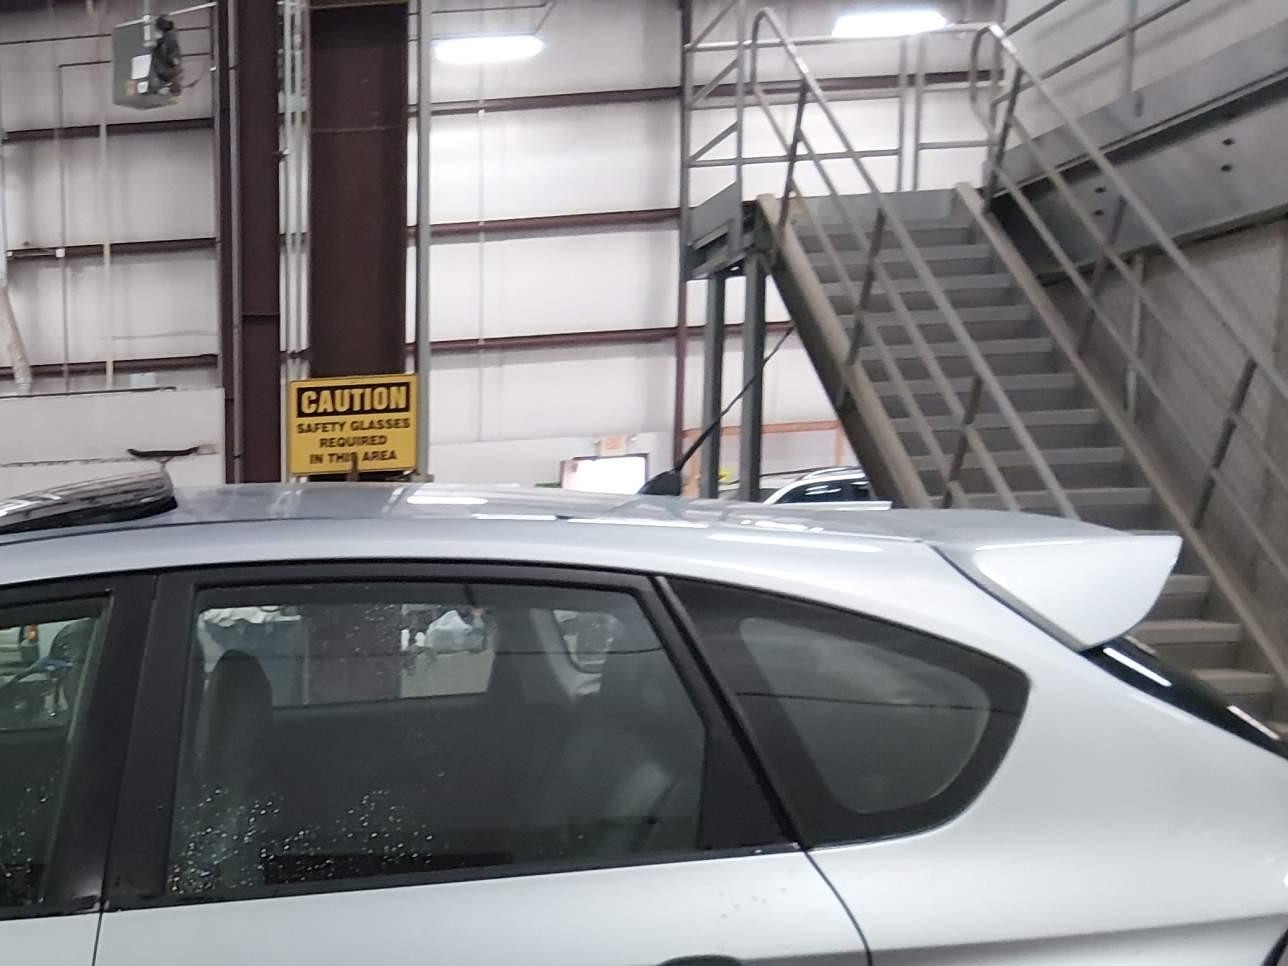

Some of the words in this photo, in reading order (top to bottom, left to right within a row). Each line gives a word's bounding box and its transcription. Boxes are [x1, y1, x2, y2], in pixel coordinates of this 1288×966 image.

[302, 386, 407, 413] CAUTION
[296, 421, 346, 433] SAFETY
[350, 418, 410, 431] GLASSES
[319, 435, 387, 448] REQUIRED
[310, 454, 324, 464] IN
[362, 450, 397, 462] AREA
